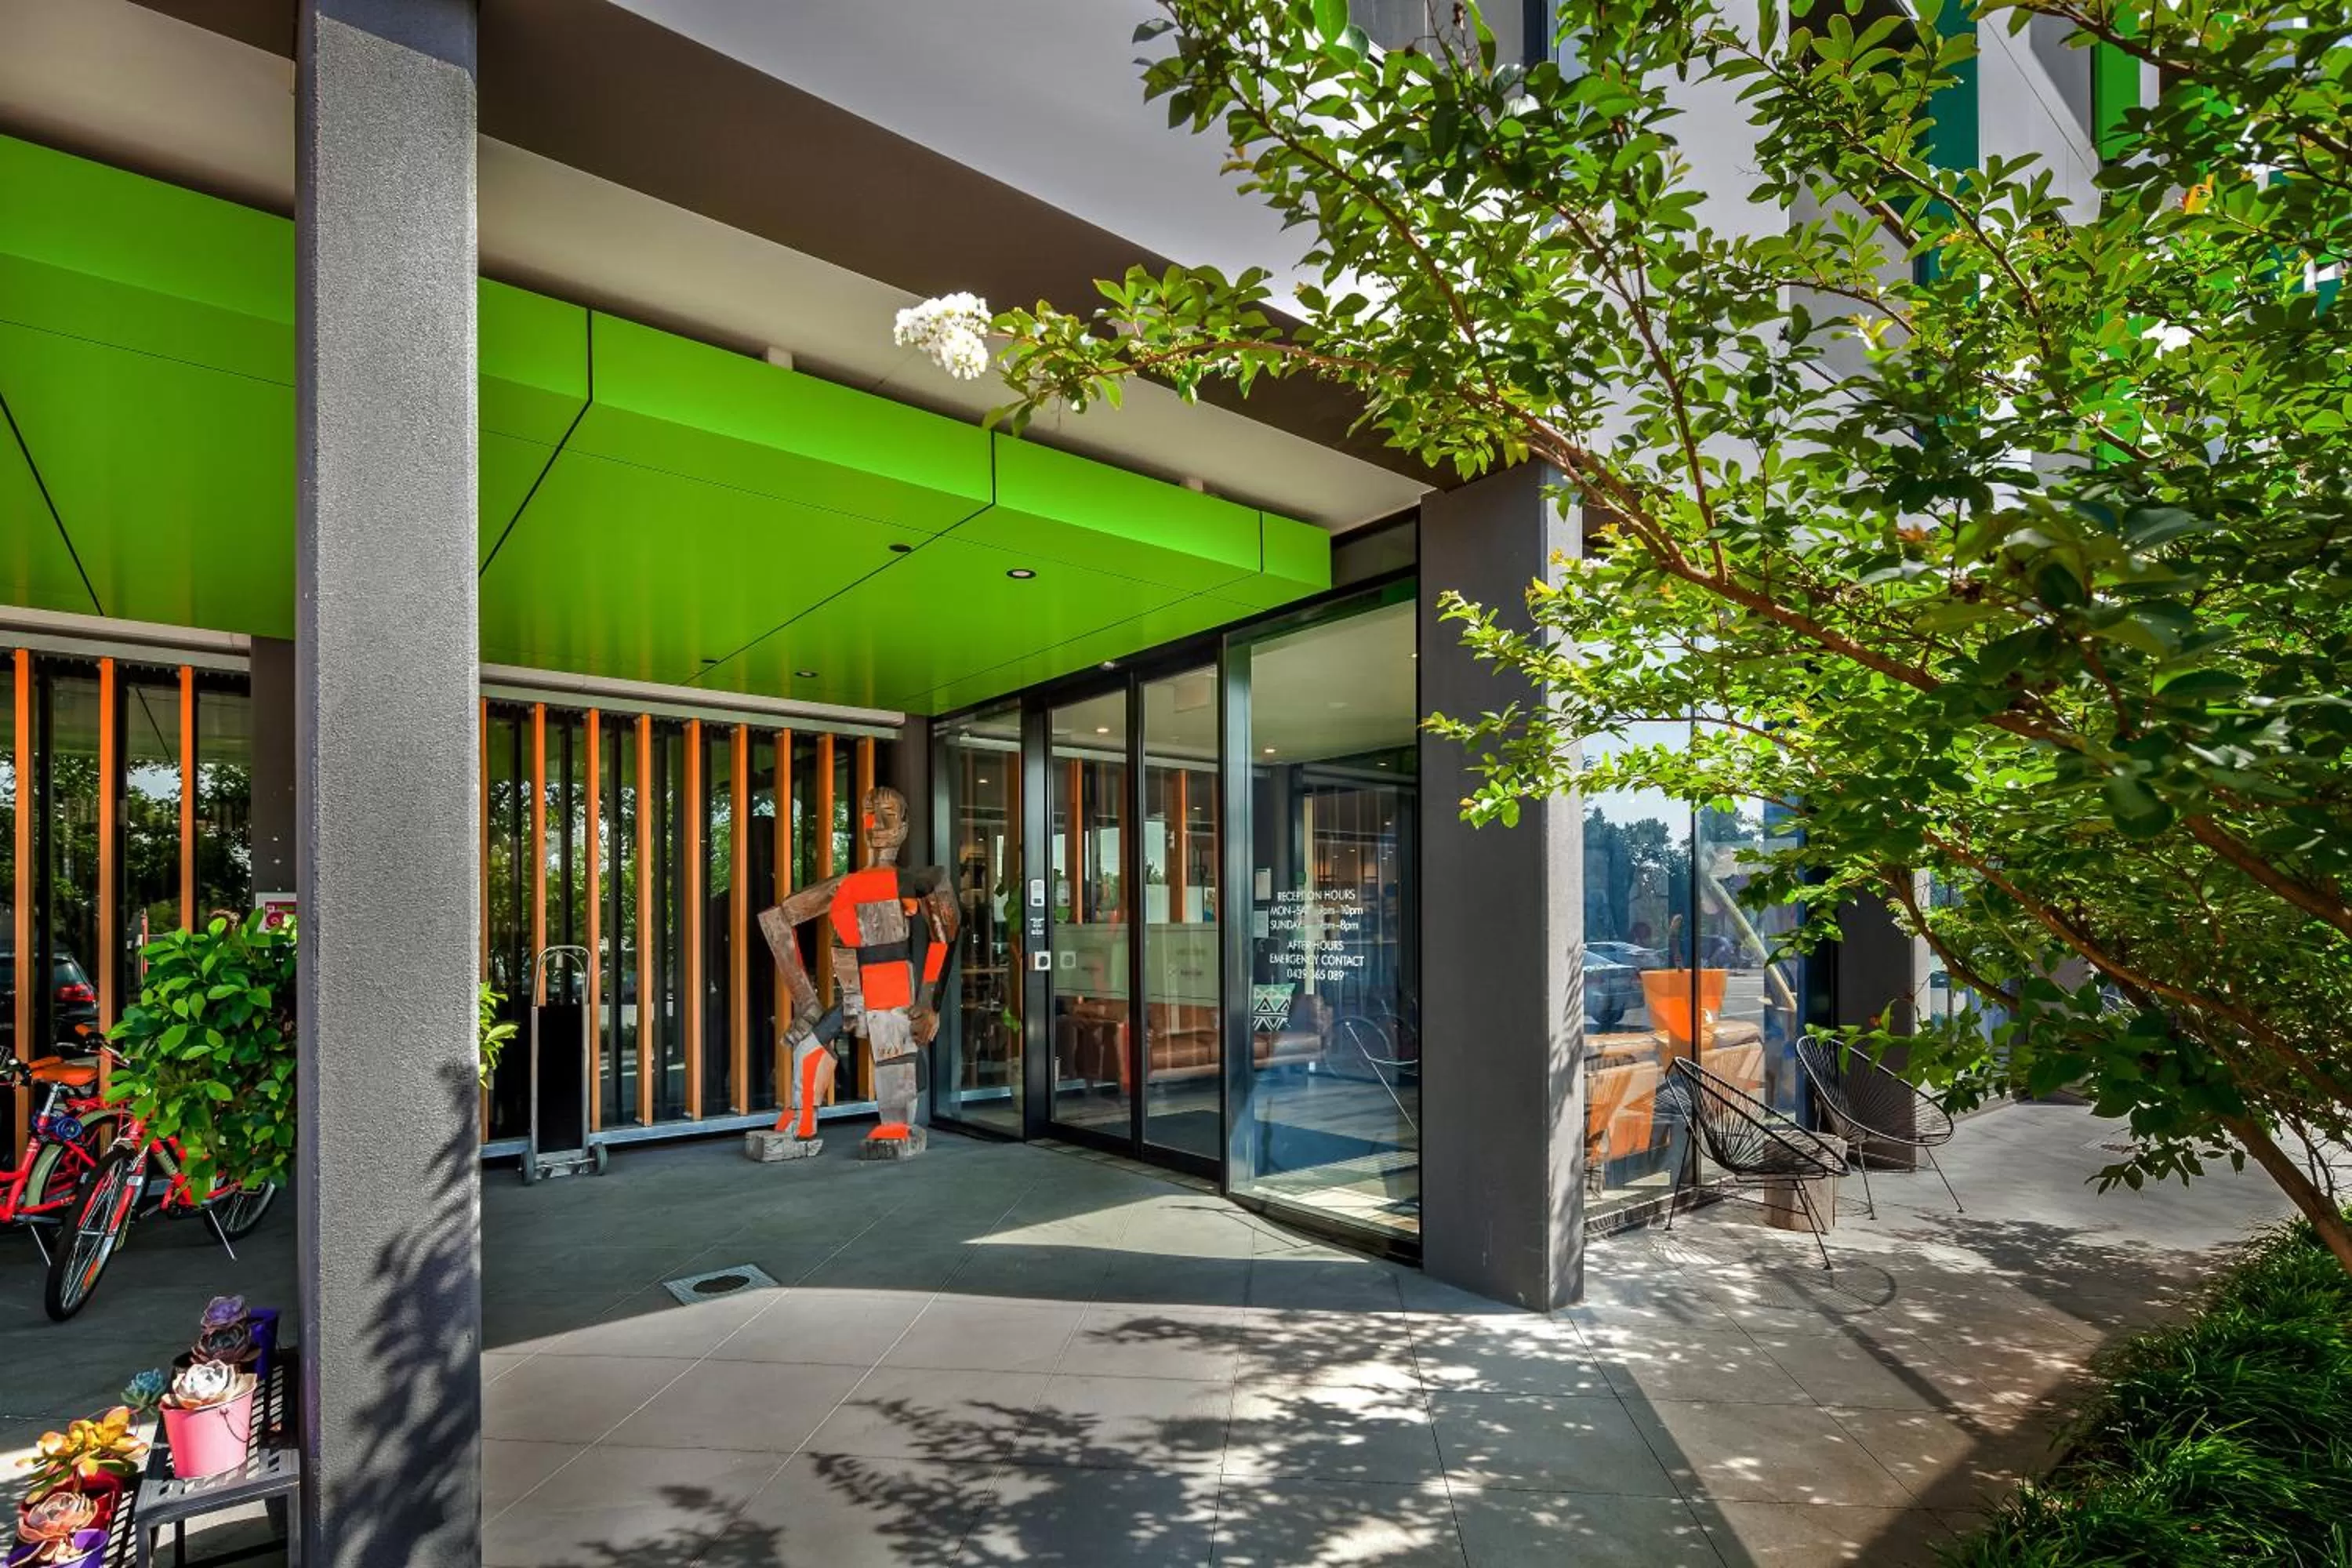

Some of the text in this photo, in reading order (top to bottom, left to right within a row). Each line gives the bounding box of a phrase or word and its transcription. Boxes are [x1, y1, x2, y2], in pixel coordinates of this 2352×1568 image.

[1278, 889, 1356, 902] RECEPTON HOURS
[1269, 920, 1301, 931] SUNDAY
[1287, 940, 1345, 951] AFTER HOURS
[1269, 953, 1365, 967] EMERGENCY CONTACT
